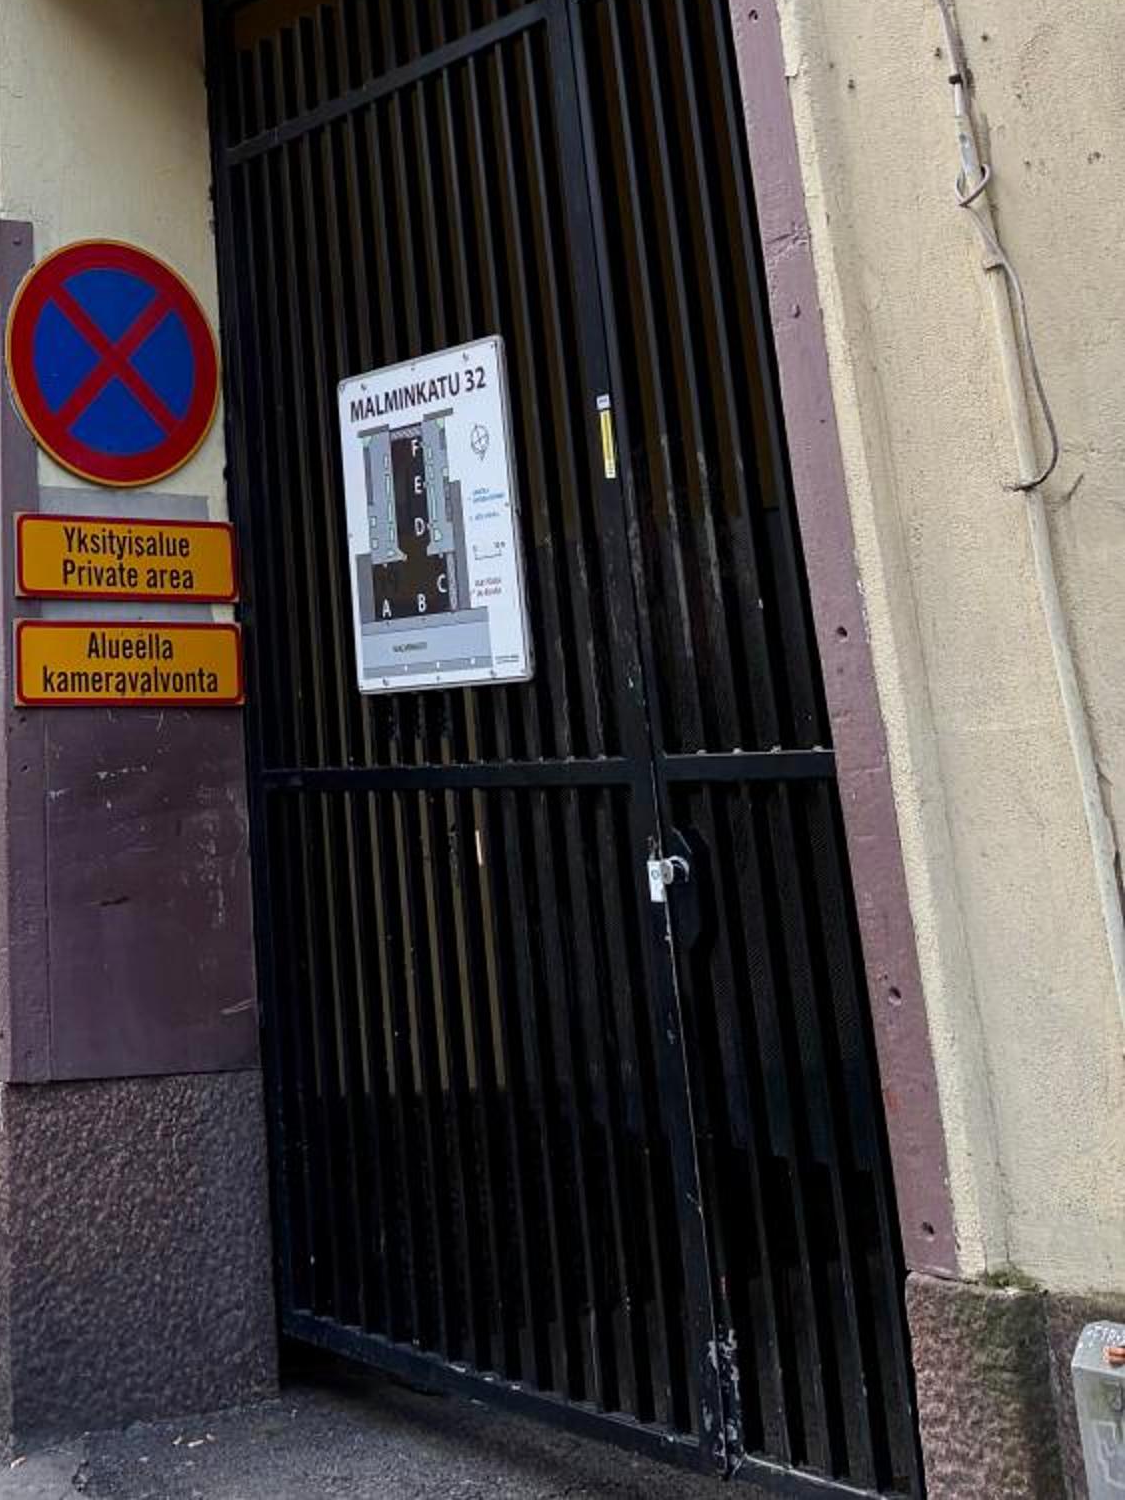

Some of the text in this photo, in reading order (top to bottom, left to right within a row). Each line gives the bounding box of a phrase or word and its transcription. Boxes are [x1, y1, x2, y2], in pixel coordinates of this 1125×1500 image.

[350, 366, 486, 422] MALMINKATU 32
[411, 439, 421, 457] F
[414, 476, 423, 494] E
[414, 517, 425, 536] D
[63, 525, 191, 560] Yksityisalue
[62, 559, 194, 589] Private area
[437, 574, 447, 593] C
[382, 599, 392, 618] A
[417, 593, 427, 612] B
[42, 665, 219, 693] kameravalvonta
